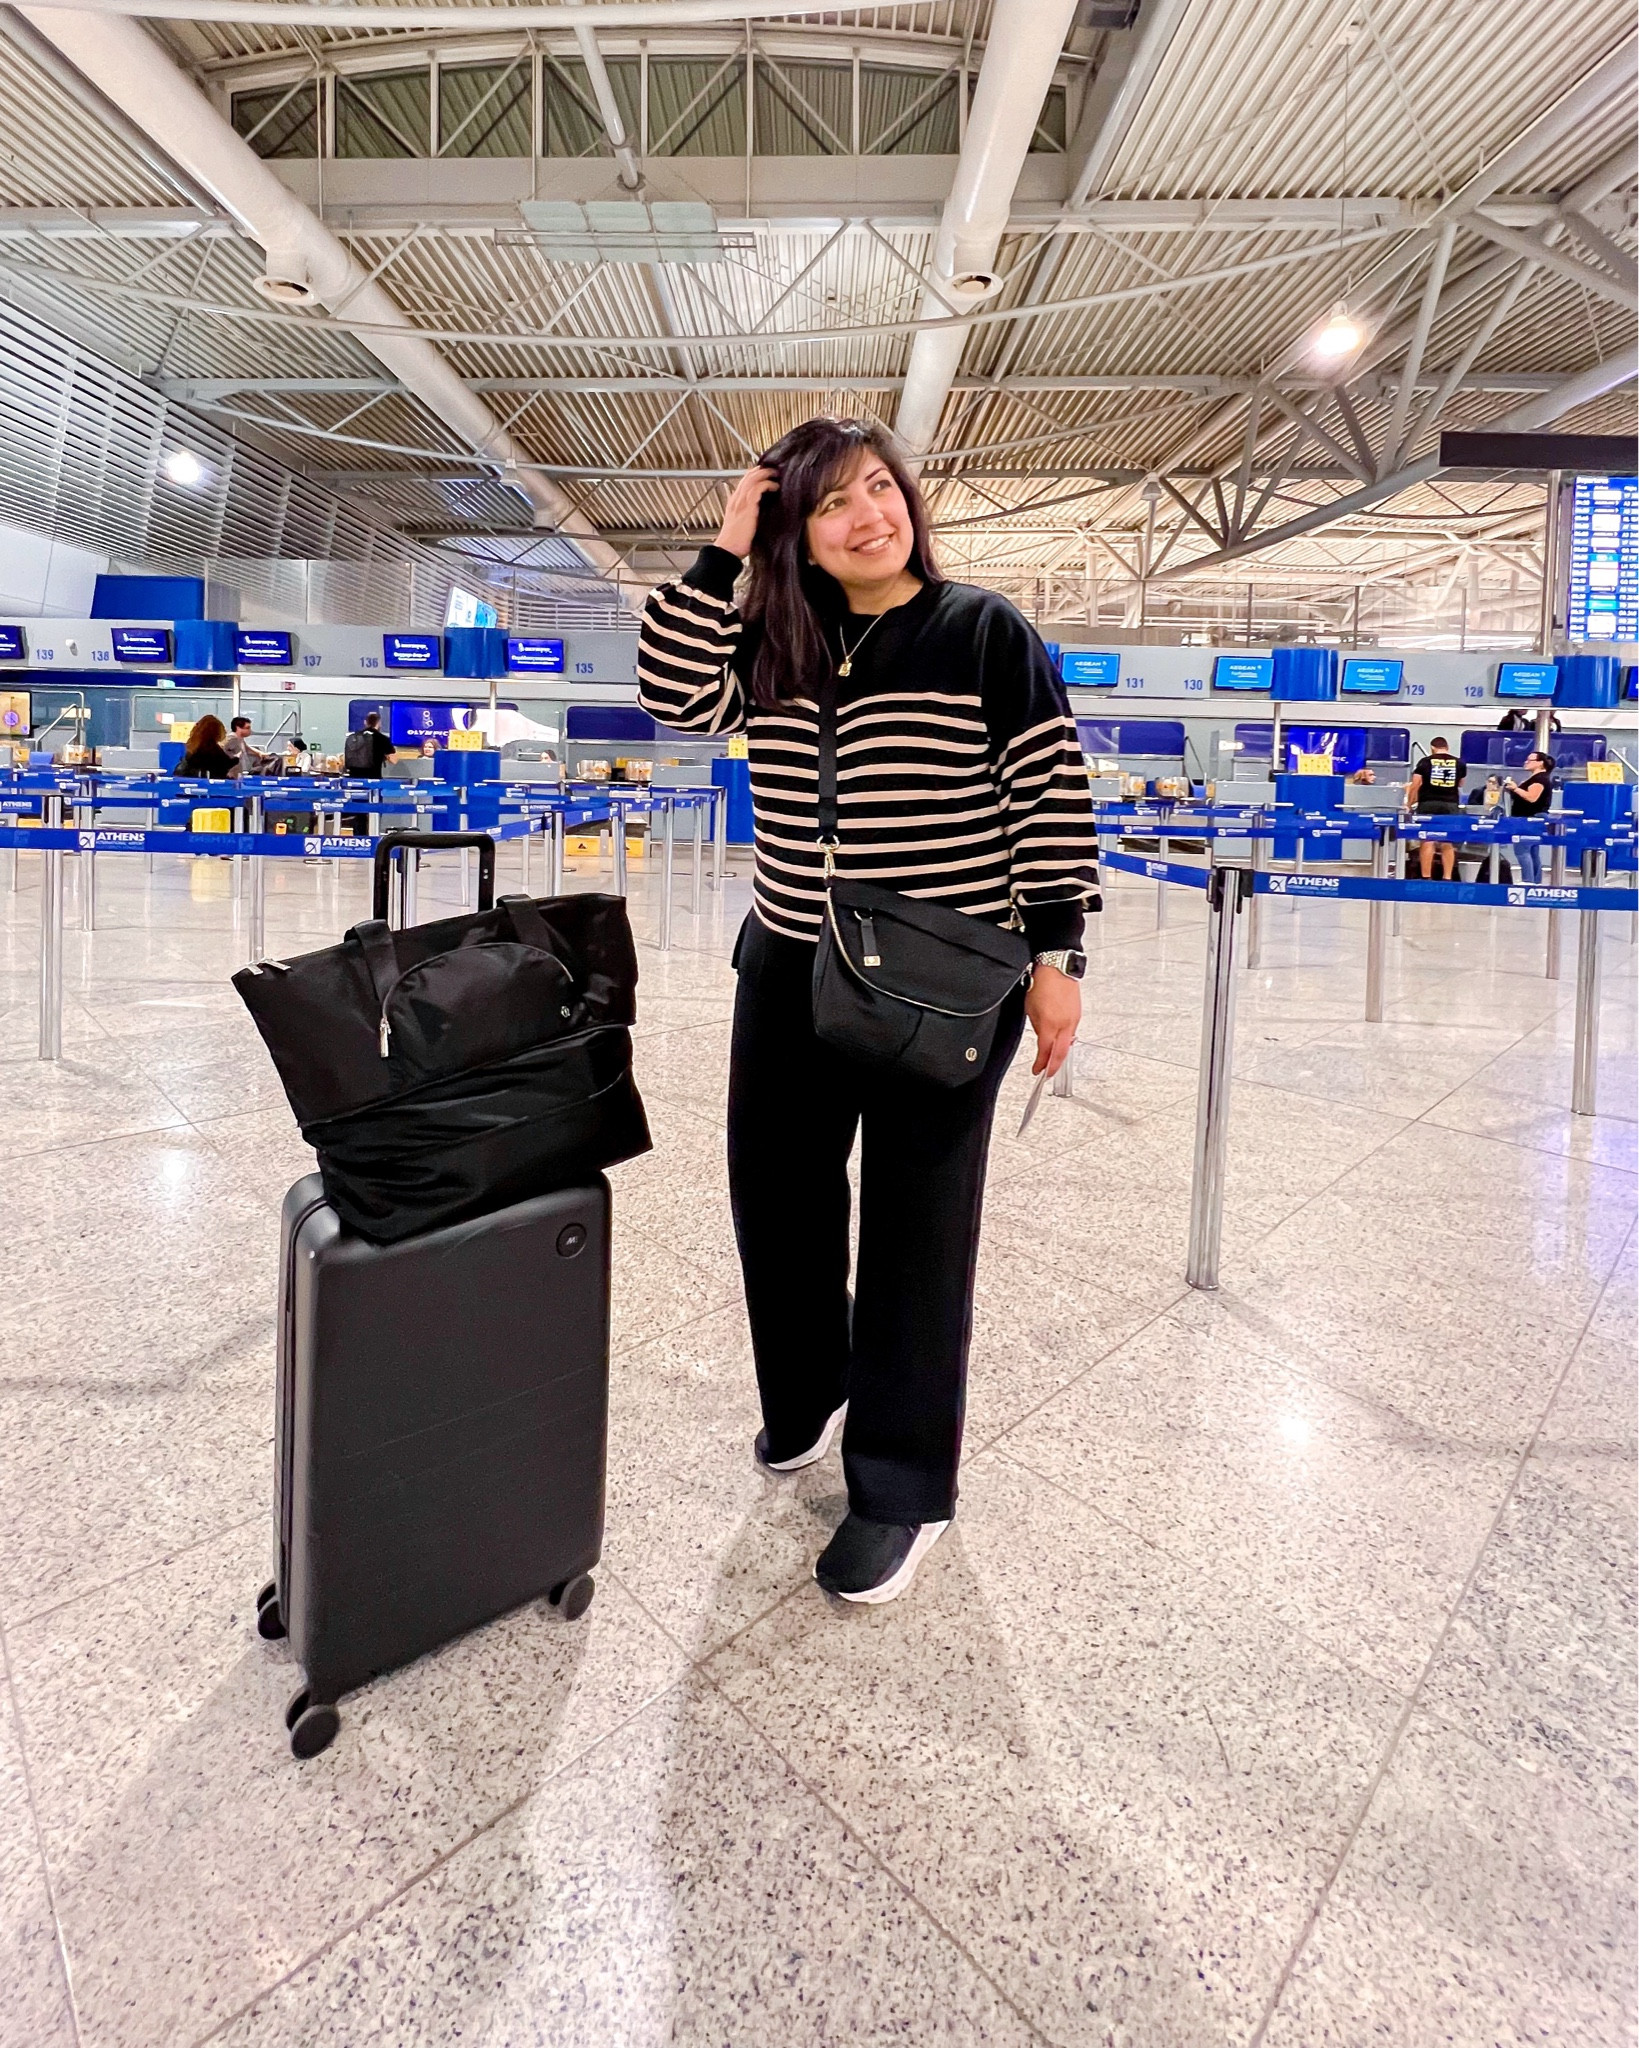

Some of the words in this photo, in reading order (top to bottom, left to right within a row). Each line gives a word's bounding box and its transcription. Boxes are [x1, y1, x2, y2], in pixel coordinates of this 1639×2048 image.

[36, 649, 54, 660] 139
[91, 651, 110, 661] 138
[303, 655, 322, 666] 137
[359, 657, 379, 668] 136
[575, 662, 594, 674] 135
[1125, 677, 1144, 688] 131
[1183, 679, 1203, 690] 130
[1405, 684, 1425, 696] 129
[1464, 686, 1484, 698] 128
[407, 729, 449, 737] OLYMPIC
[96, 832, 146, 842] ATHENS
[322, 837, 372, 847] ATHENS
[1287, 876, 1340, 887] ATHENS
[1526, 888, 1578, 898] ATHENS
